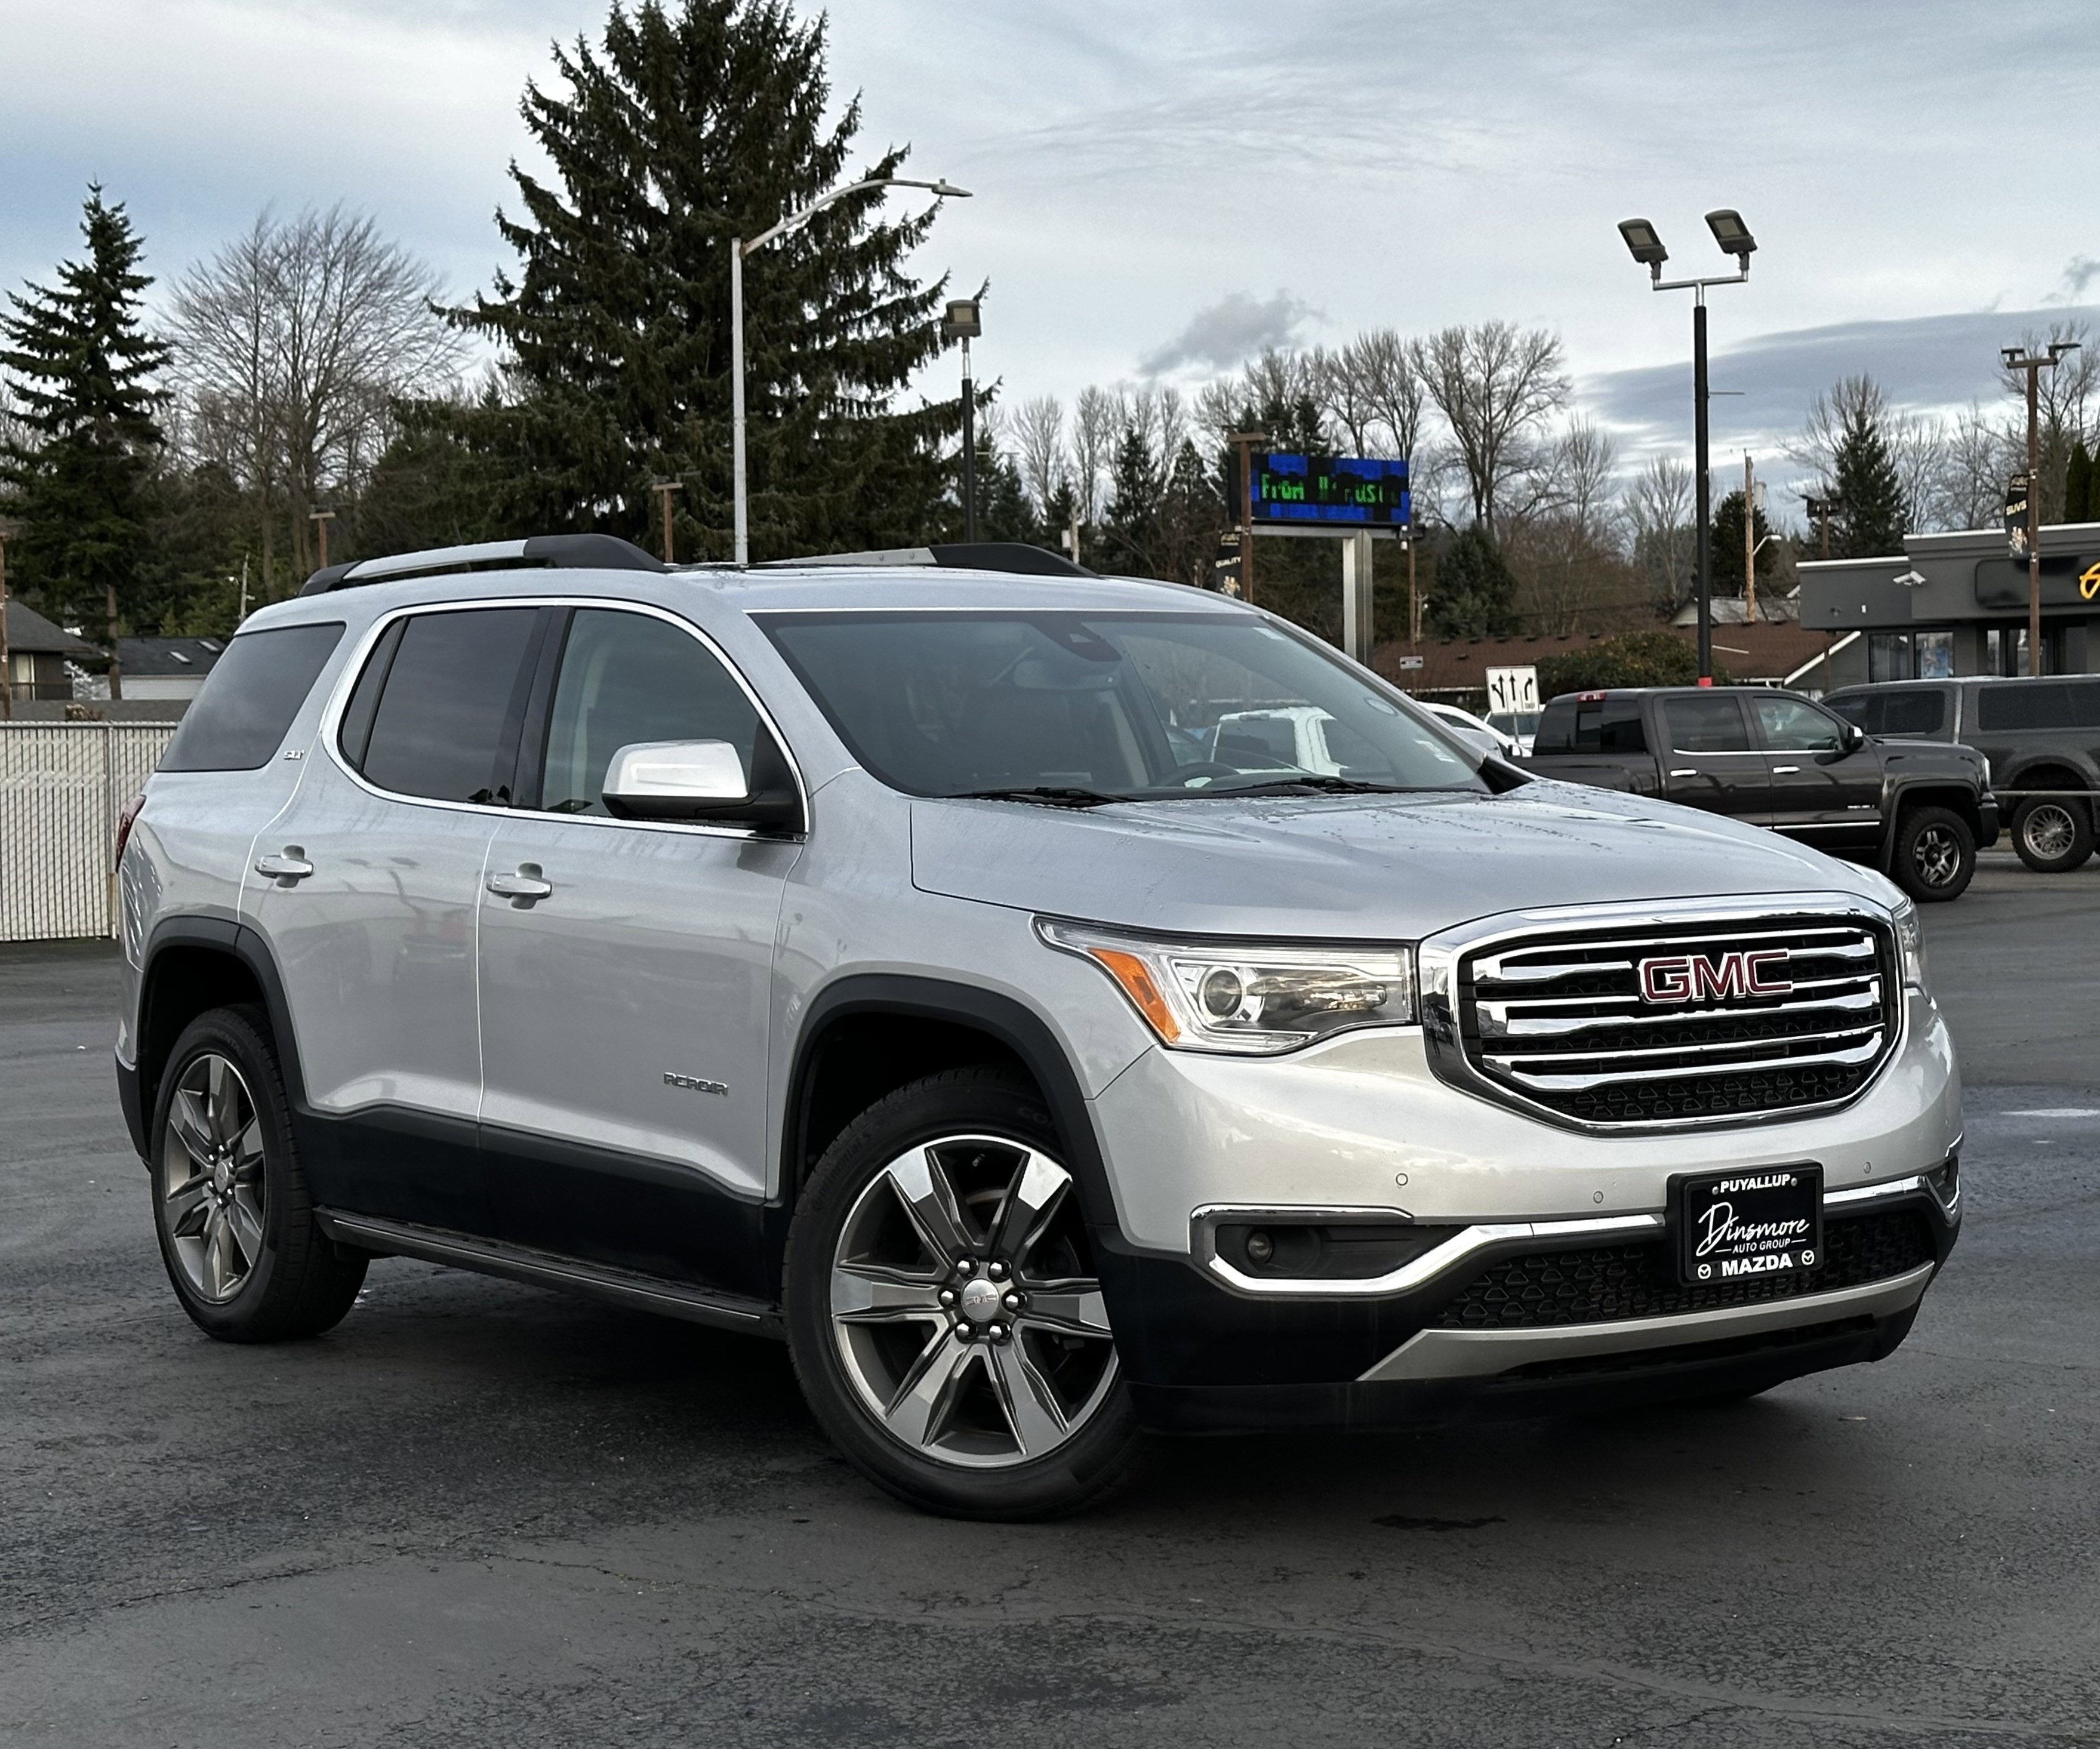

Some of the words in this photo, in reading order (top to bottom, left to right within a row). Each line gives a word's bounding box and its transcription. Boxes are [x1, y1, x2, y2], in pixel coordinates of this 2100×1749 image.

[1637, 948, 1793, 1004] GMC
[1720, 1174, 1790, 1193] PUYALLUP
[1696, 1202, 1810, 1257] Dinsmore
[1732, 1242, 1757, 1254] AUTO
[1759, 1238, 1791, 1251] GROUP
[1722, 1253, 1793, 1277] MAZDA
